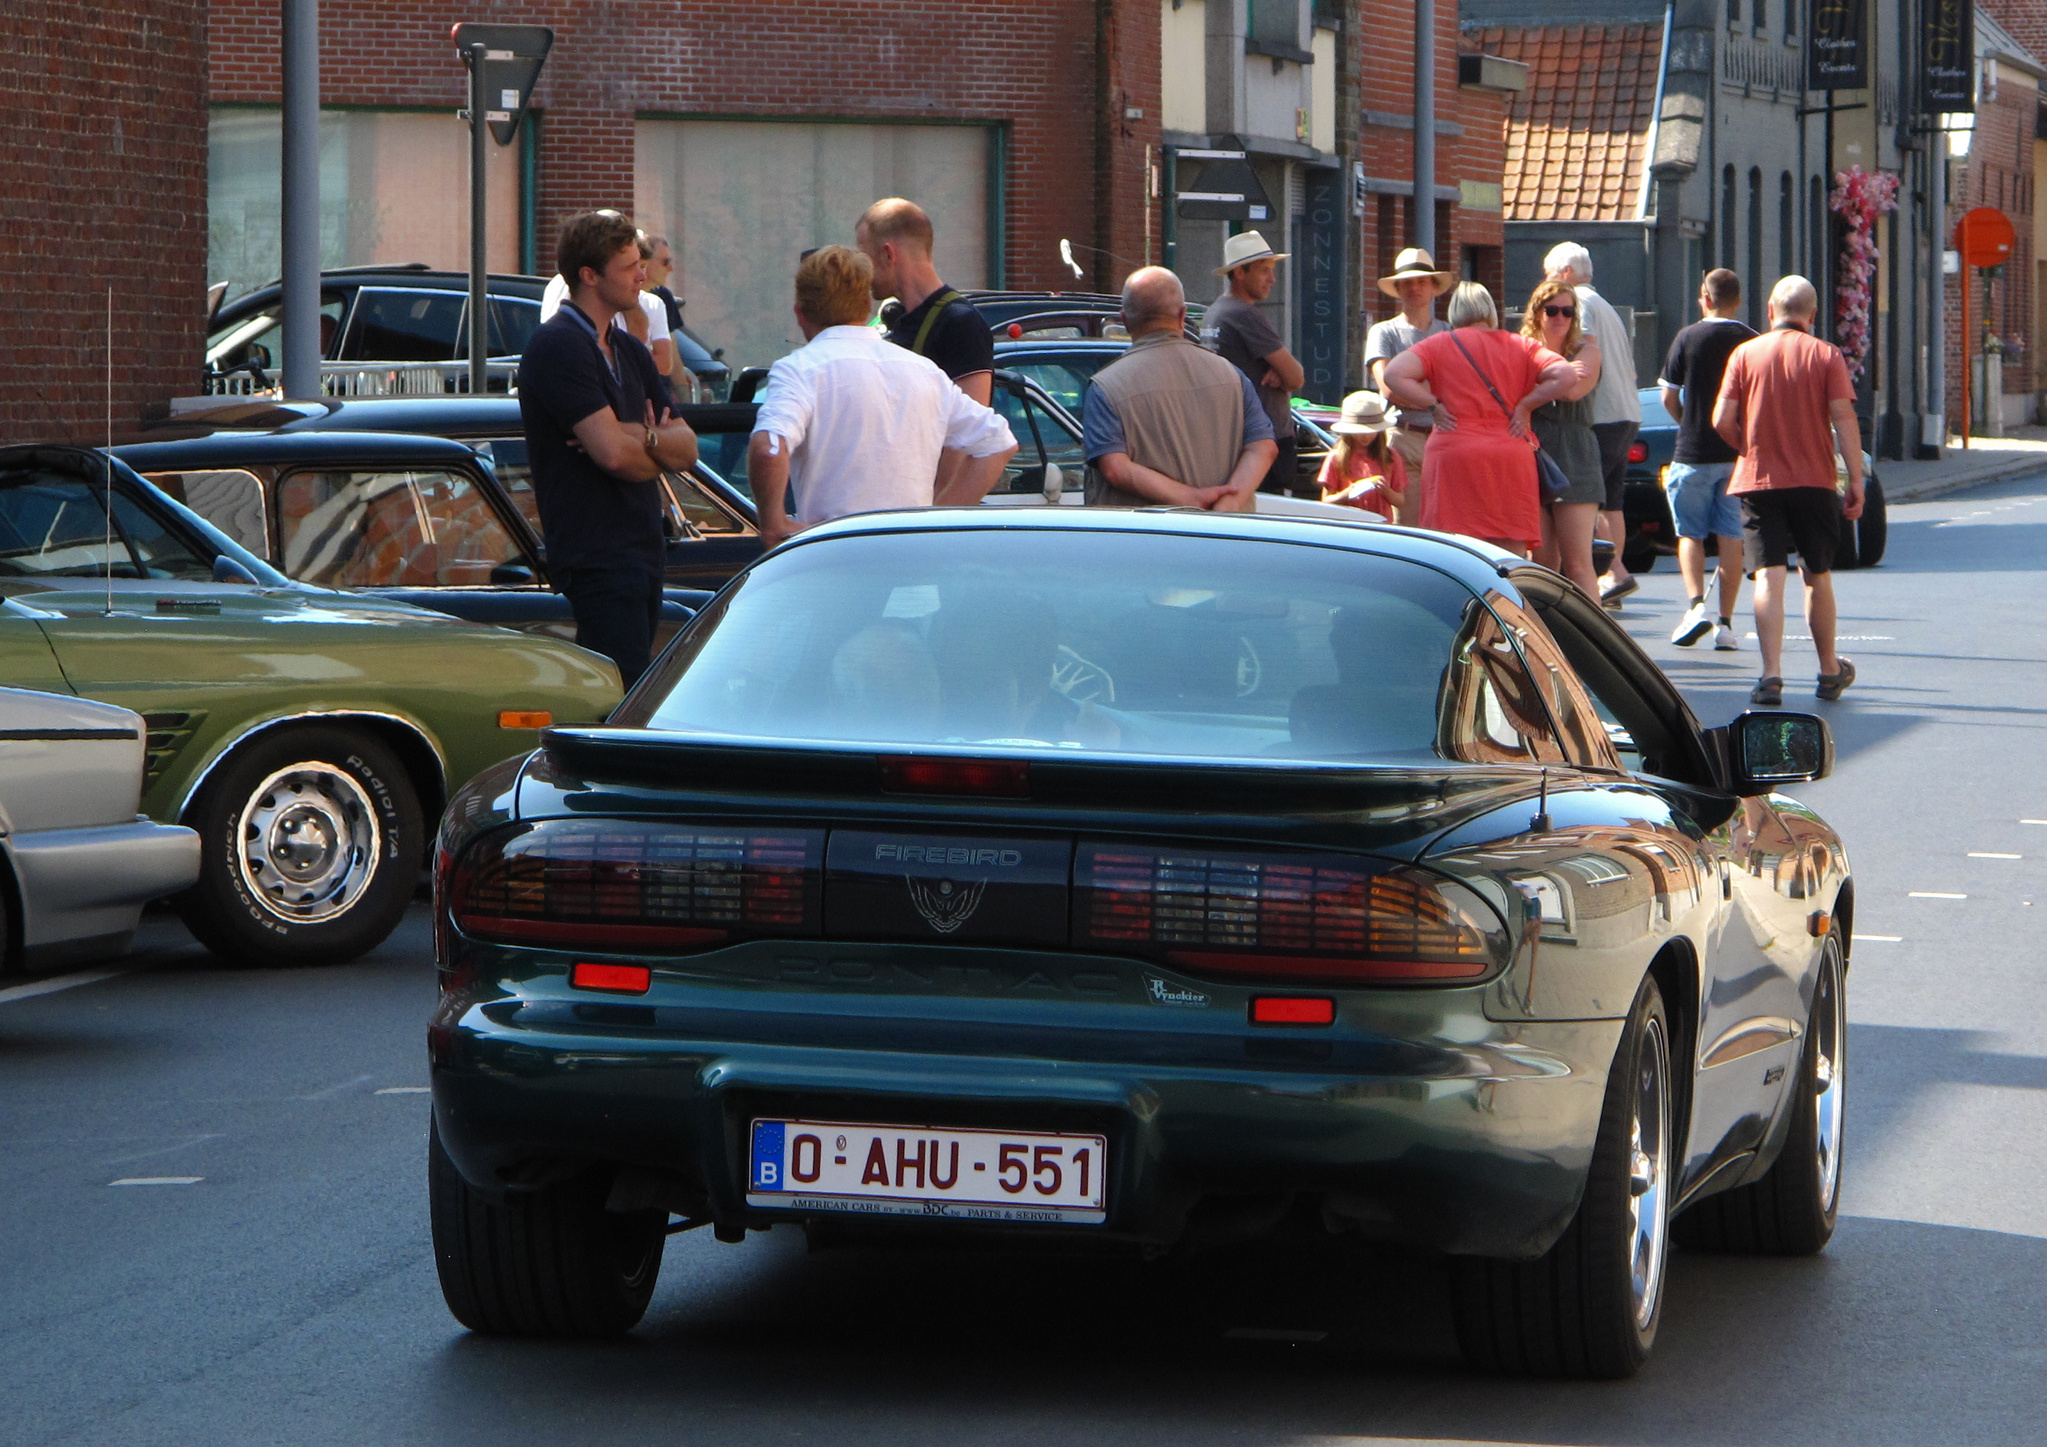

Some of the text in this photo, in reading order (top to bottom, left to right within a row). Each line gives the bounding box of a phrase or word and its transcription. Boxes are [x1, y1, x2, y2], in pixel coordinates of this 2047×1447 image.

[347, 755, 399, 859] Radial T/A
[875, 844, 1022, 867] FIREBIRD
[774, 955, 1120, 996] PONTIAC
[761, 1162, 777, 1185] B
[791, 1199, 848, 1211] AMERICAN
[852, 1202, 880, 1212] CARS
[968, 1208, 1001, 1219] PARTS
[1004, 1210, 1014, 1219] &
[1016, 1211, 1063, 1221] SERVICE
